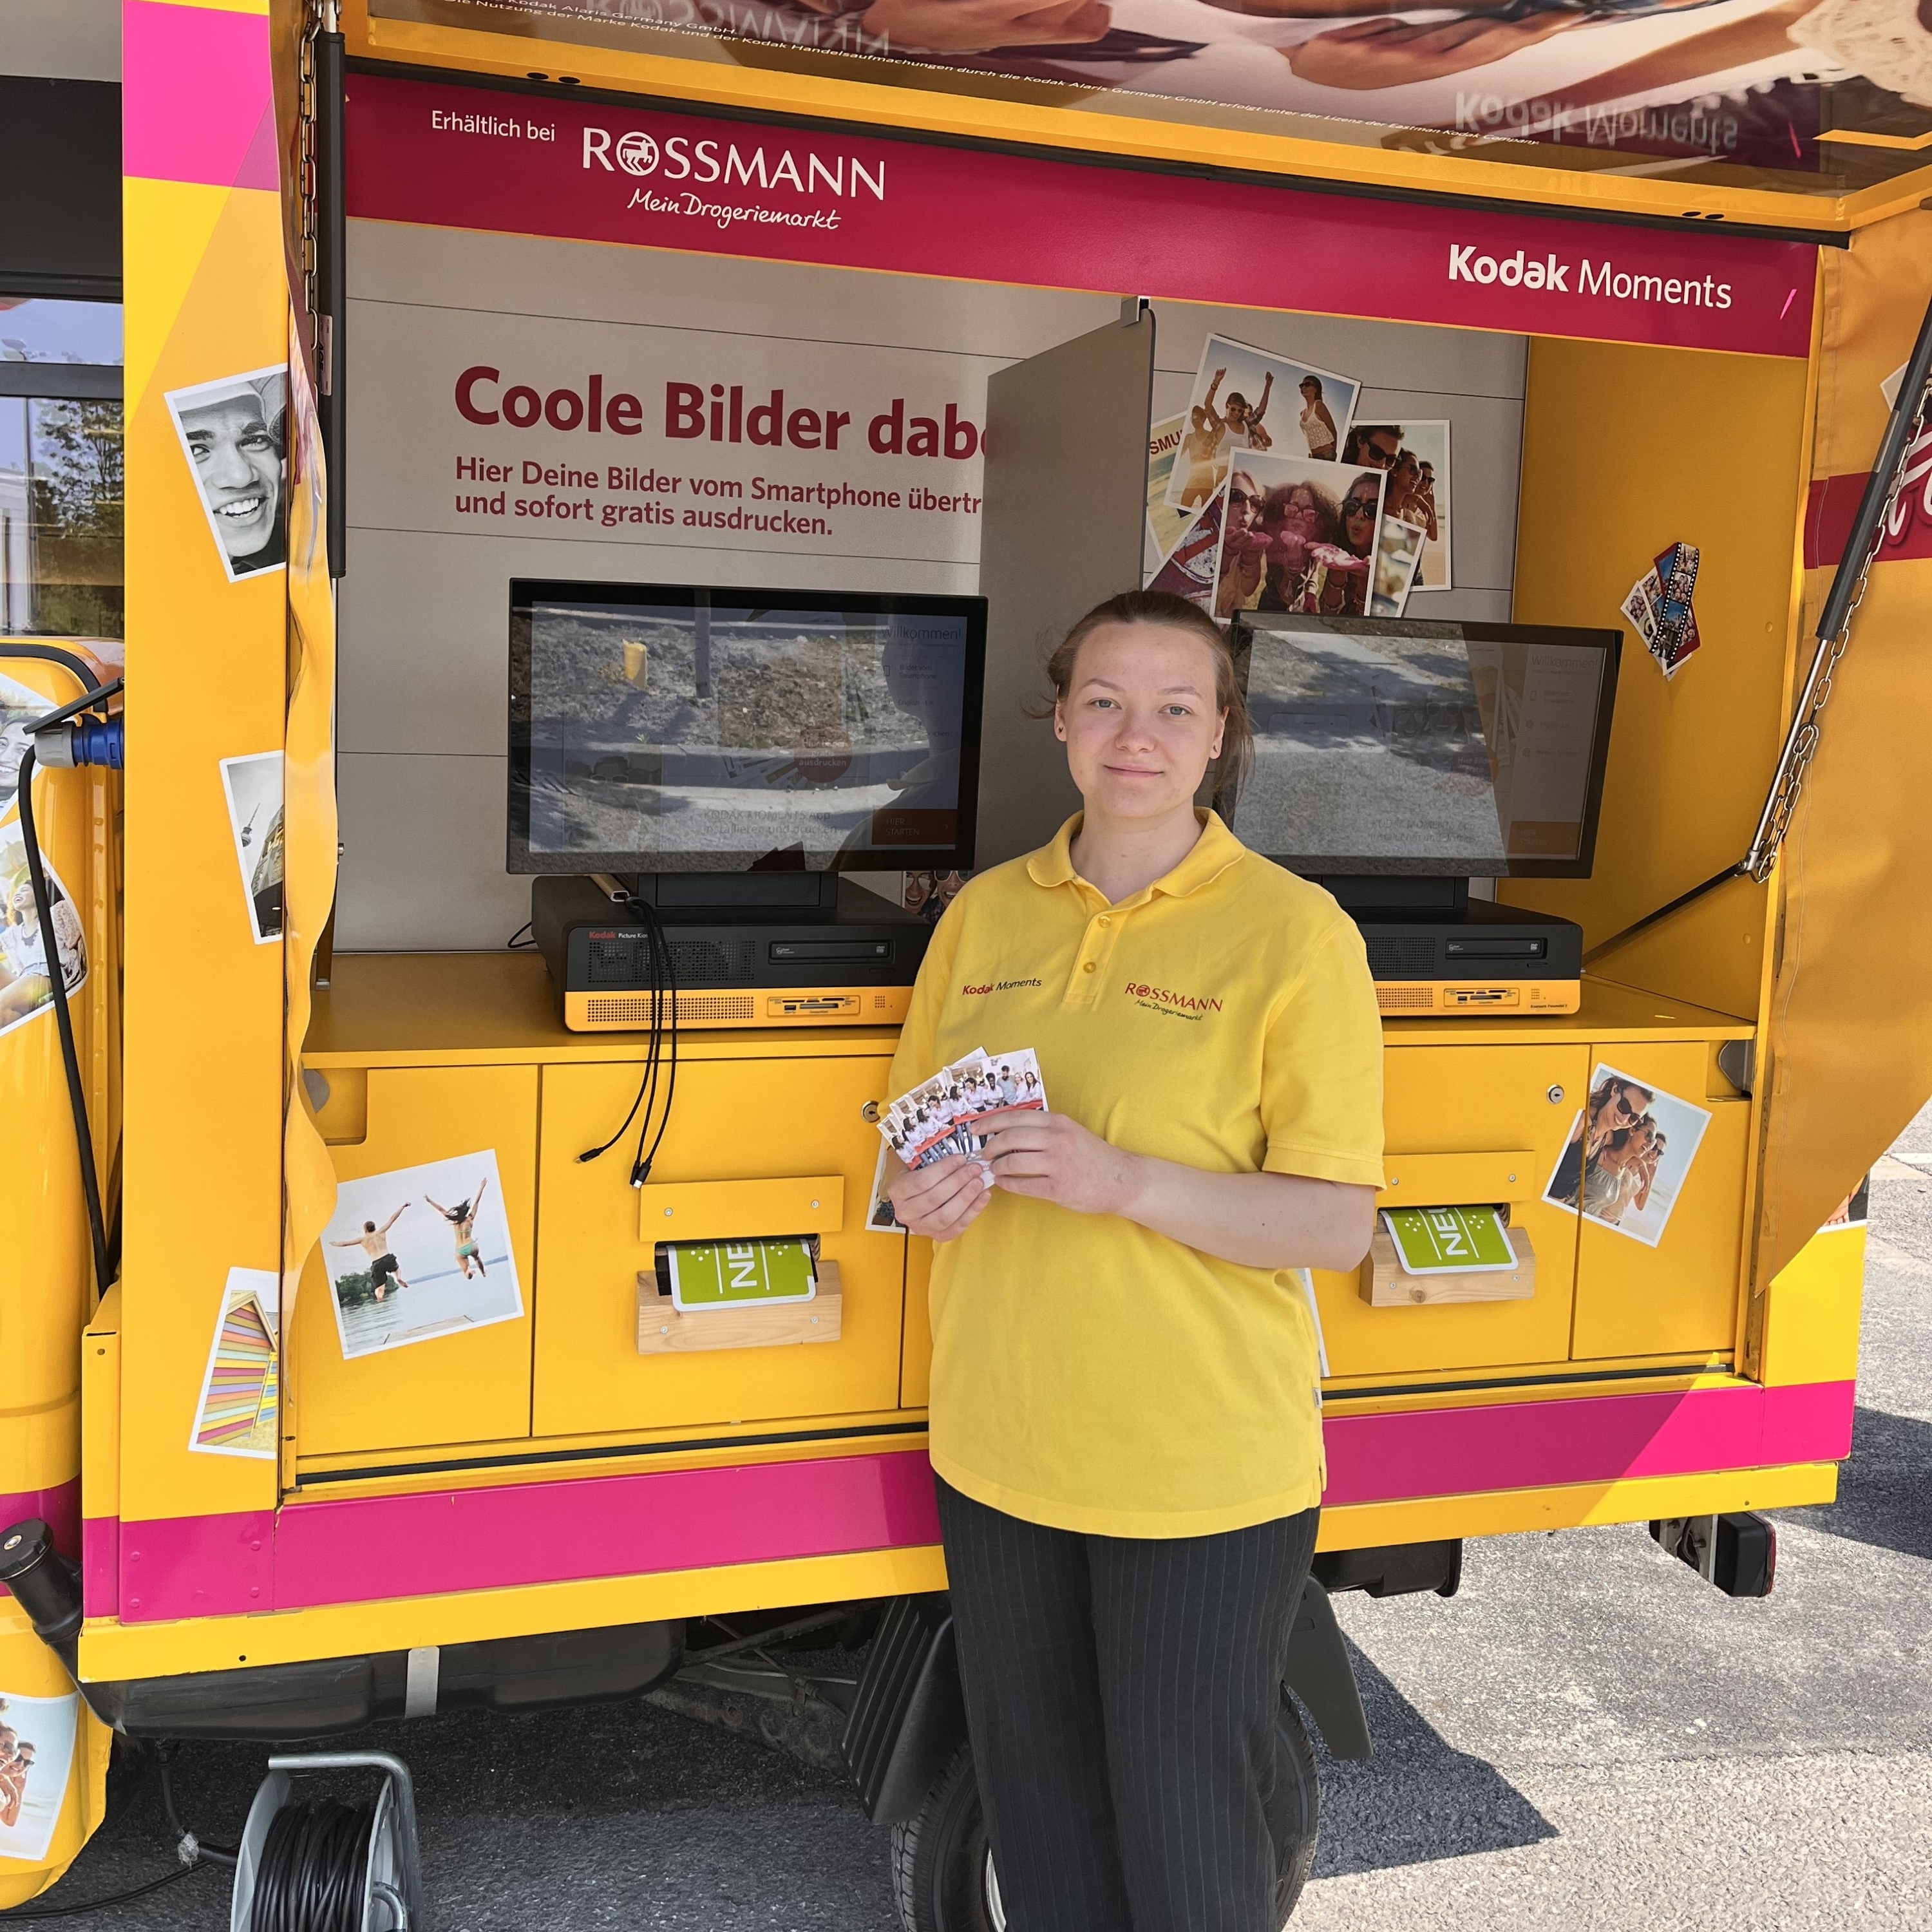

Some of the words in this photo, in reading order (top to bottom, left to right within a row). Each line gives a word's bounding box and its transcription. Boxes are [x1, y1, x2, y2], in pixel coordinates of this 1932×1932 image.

[562, 5, 607, 17] Alaris
[612, 12, 682, 27] Germany
[686, 23, 738, 35] GmbH.
[477, 1, 542, 15] Nutzung
[547, 10, 573, 19] der
[577, 14, 626, 26] Marke
[630, 22, 677, 33] Kodak
[681, 30, 710, 38] und
[714, 33, 739, 42] der
[742, 37, 787, 49] Kodak
[791, 44, 954, 72] Handelsaufmachungen
[956, 66, 997, 77] durch
[999, 72, 1021, 81] die
[1024, 75, 1065, 86] Kodak
[1068, 81, 1108, 92] Alaris
[1112, 88, 1173, 101] Germany
[1175, 95, 1218, 107] GmbH
[1219, 100, 1263, 112] erfolgt
[1264, 107, 1300, 117] unter
[1300, 111, 1323, 120] der
[1323, 114, 1364, 126] Lizenz
[1365, 120, 1388, 128] der
[1388, 122, 1441, 135] Eastman
[1442, 129, 1481, 138] Kodak
[1482, 134, 1540, 146] Company.
[431, 109, 521, 138] Erhältlich
[527, 120, 555, 142] bei
[582, 126, 886, 202] ROSSMANN
[627, 187, 681, 215] Mein
[680, 192, 842, 230] Drogeriemarkt
[1448, 243, 1569, 292] Kodak
[1578, 258, 1732, 309] Moments
[454, 365, 643, 436] Coole
[665, 381, 851, 451] Bilder
[867, 397, 987, 460] dab
[1149, 429, 1183, 455] SMU
[455, 455, 514, 483] Hier
[522, 460, 600, 489] Deine
[607, 466, 683, 494] Bilder
[689, 477, 743, 498] vom
[751, 476, 902, 509] Smartphone
[455, 490, 506, 516] und
[514, 494, 594, 521] sofort
[601, 501, 676, 527] gratis
[681, 506, 834, 536] ausdrucken.
[880, 625, 961, 640] Willkommen!
[799, 758, 847, 766] ausdrucken
[886, 817, 905, 826] HIER
[886, 828, 920, 837] STARTEN
[962, 983, 995, 996] Kodak
[996, 978, 1042, 991] Moments
[1124, 982, 1224, 1012] ROSSMANN
[1134, 999, 1151, 1009] Mein
[1151, 1002, 1204, 1021] Drogeriemarkt
